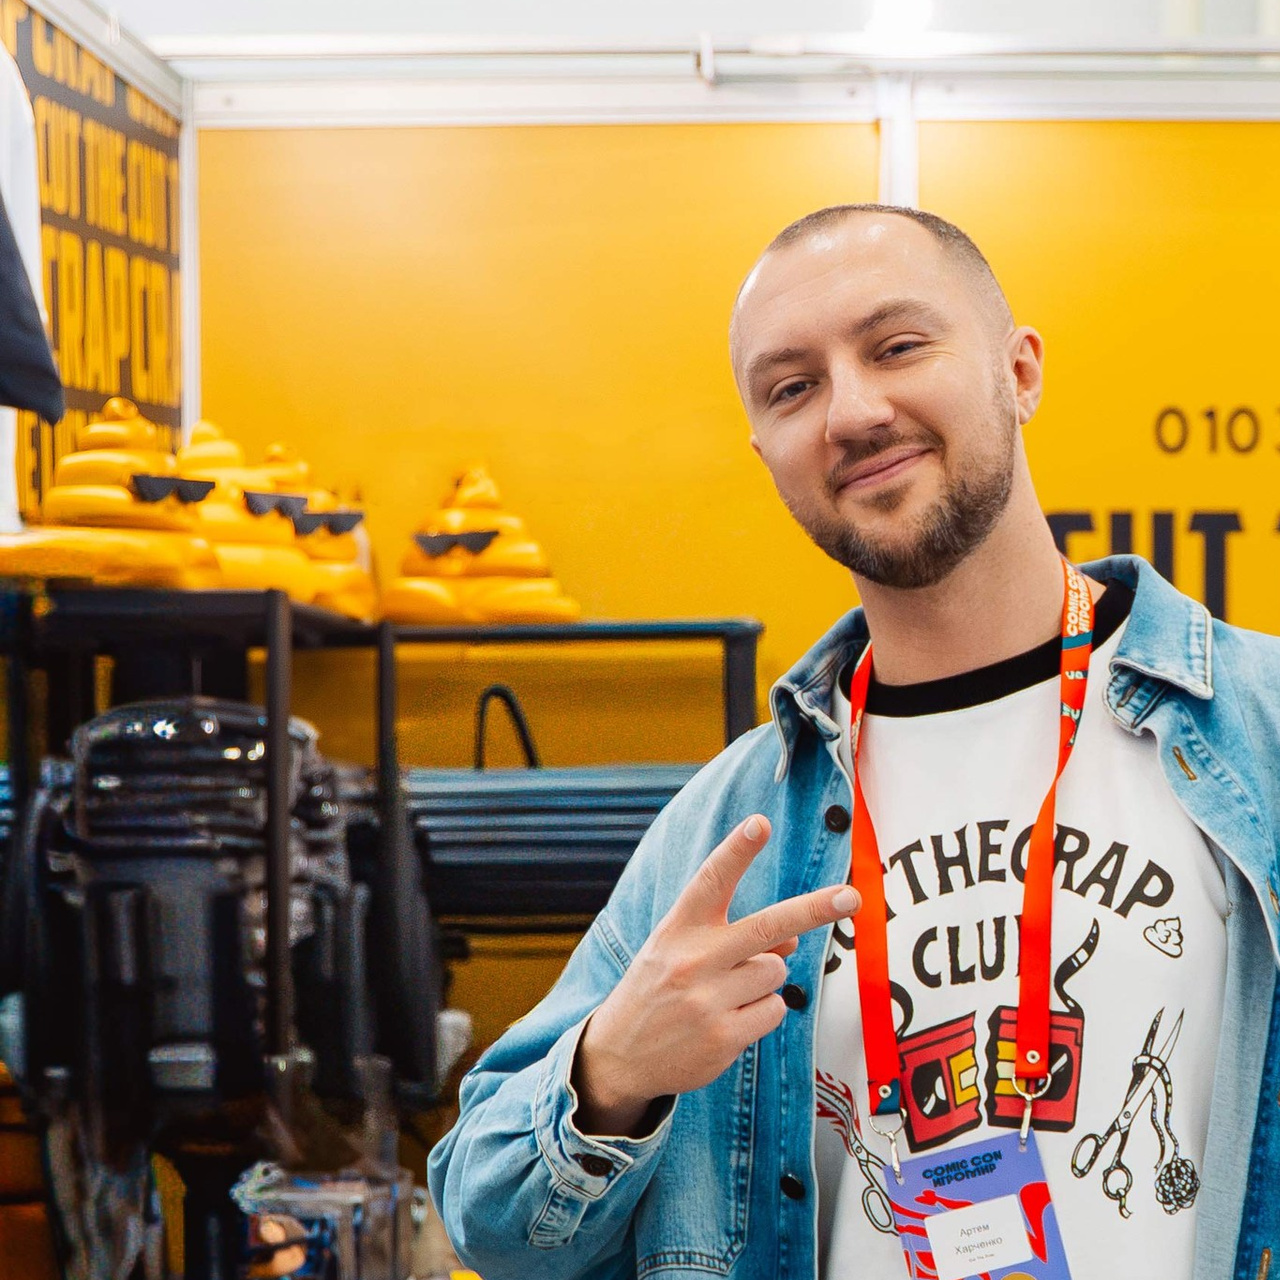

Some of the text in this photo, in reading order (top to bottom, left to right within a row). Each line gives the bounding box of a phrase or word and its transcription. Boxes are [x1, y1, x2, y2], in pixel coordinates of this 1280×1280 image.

[912, 915, 1023, 988] CLU
[922, 1150, 1003, 1179] COMIC CON
[932, 1163, 996, 1188] ИГРОМИР
[960, 1224, 990, 1238] Артем
[955, 1237, 1003, 1256] Харченко
